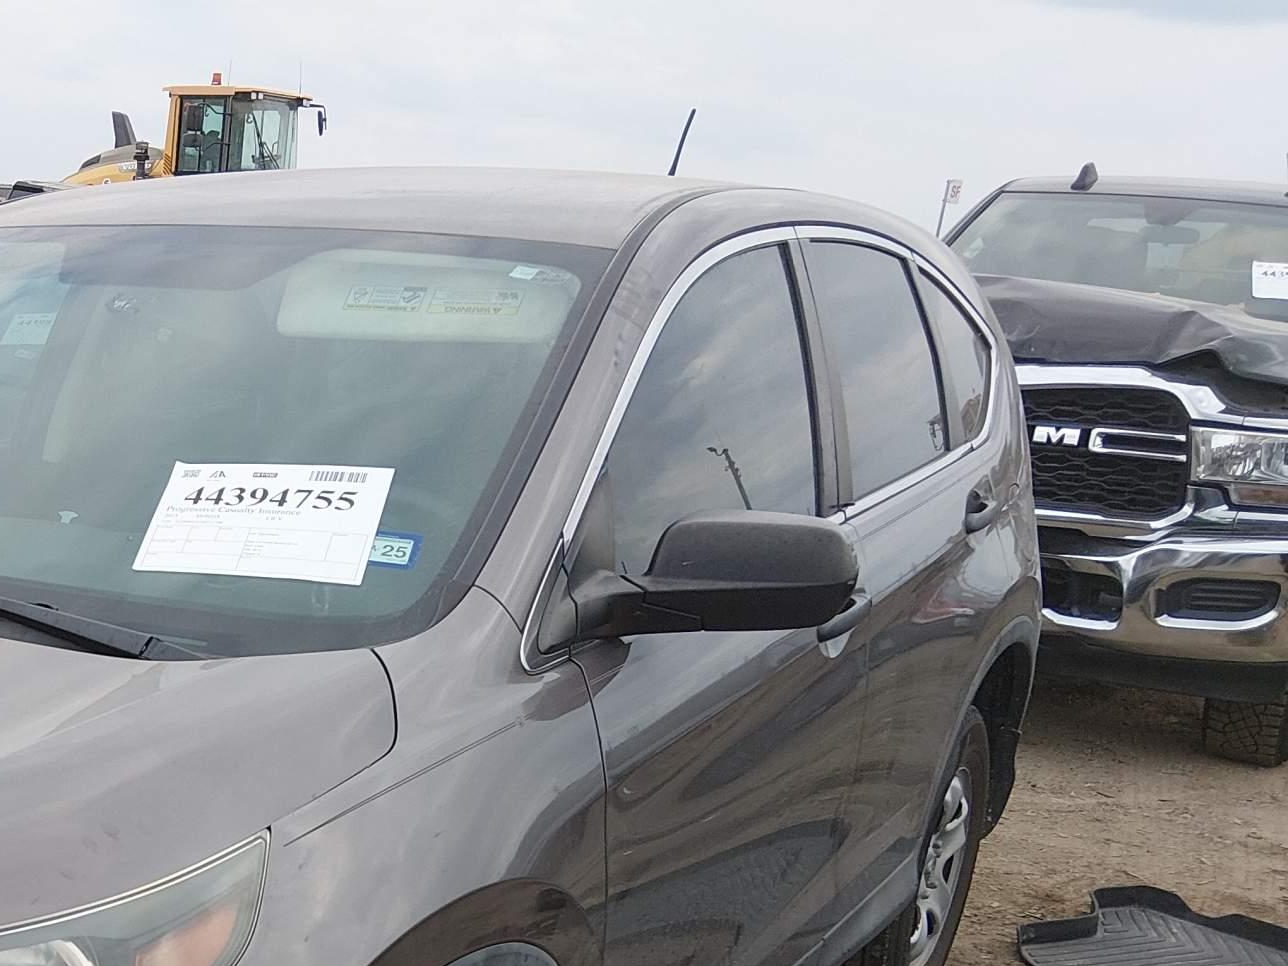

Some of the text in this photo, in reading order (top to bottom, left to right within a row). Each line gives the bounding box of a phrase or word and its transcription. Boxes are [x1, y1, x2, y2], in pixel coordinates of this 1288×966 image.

[183, 485, 359, 511] 44394755
[166, 505, 301, 516] Progressive Casualty Insurance
[381, 544, 408, 559] 25
